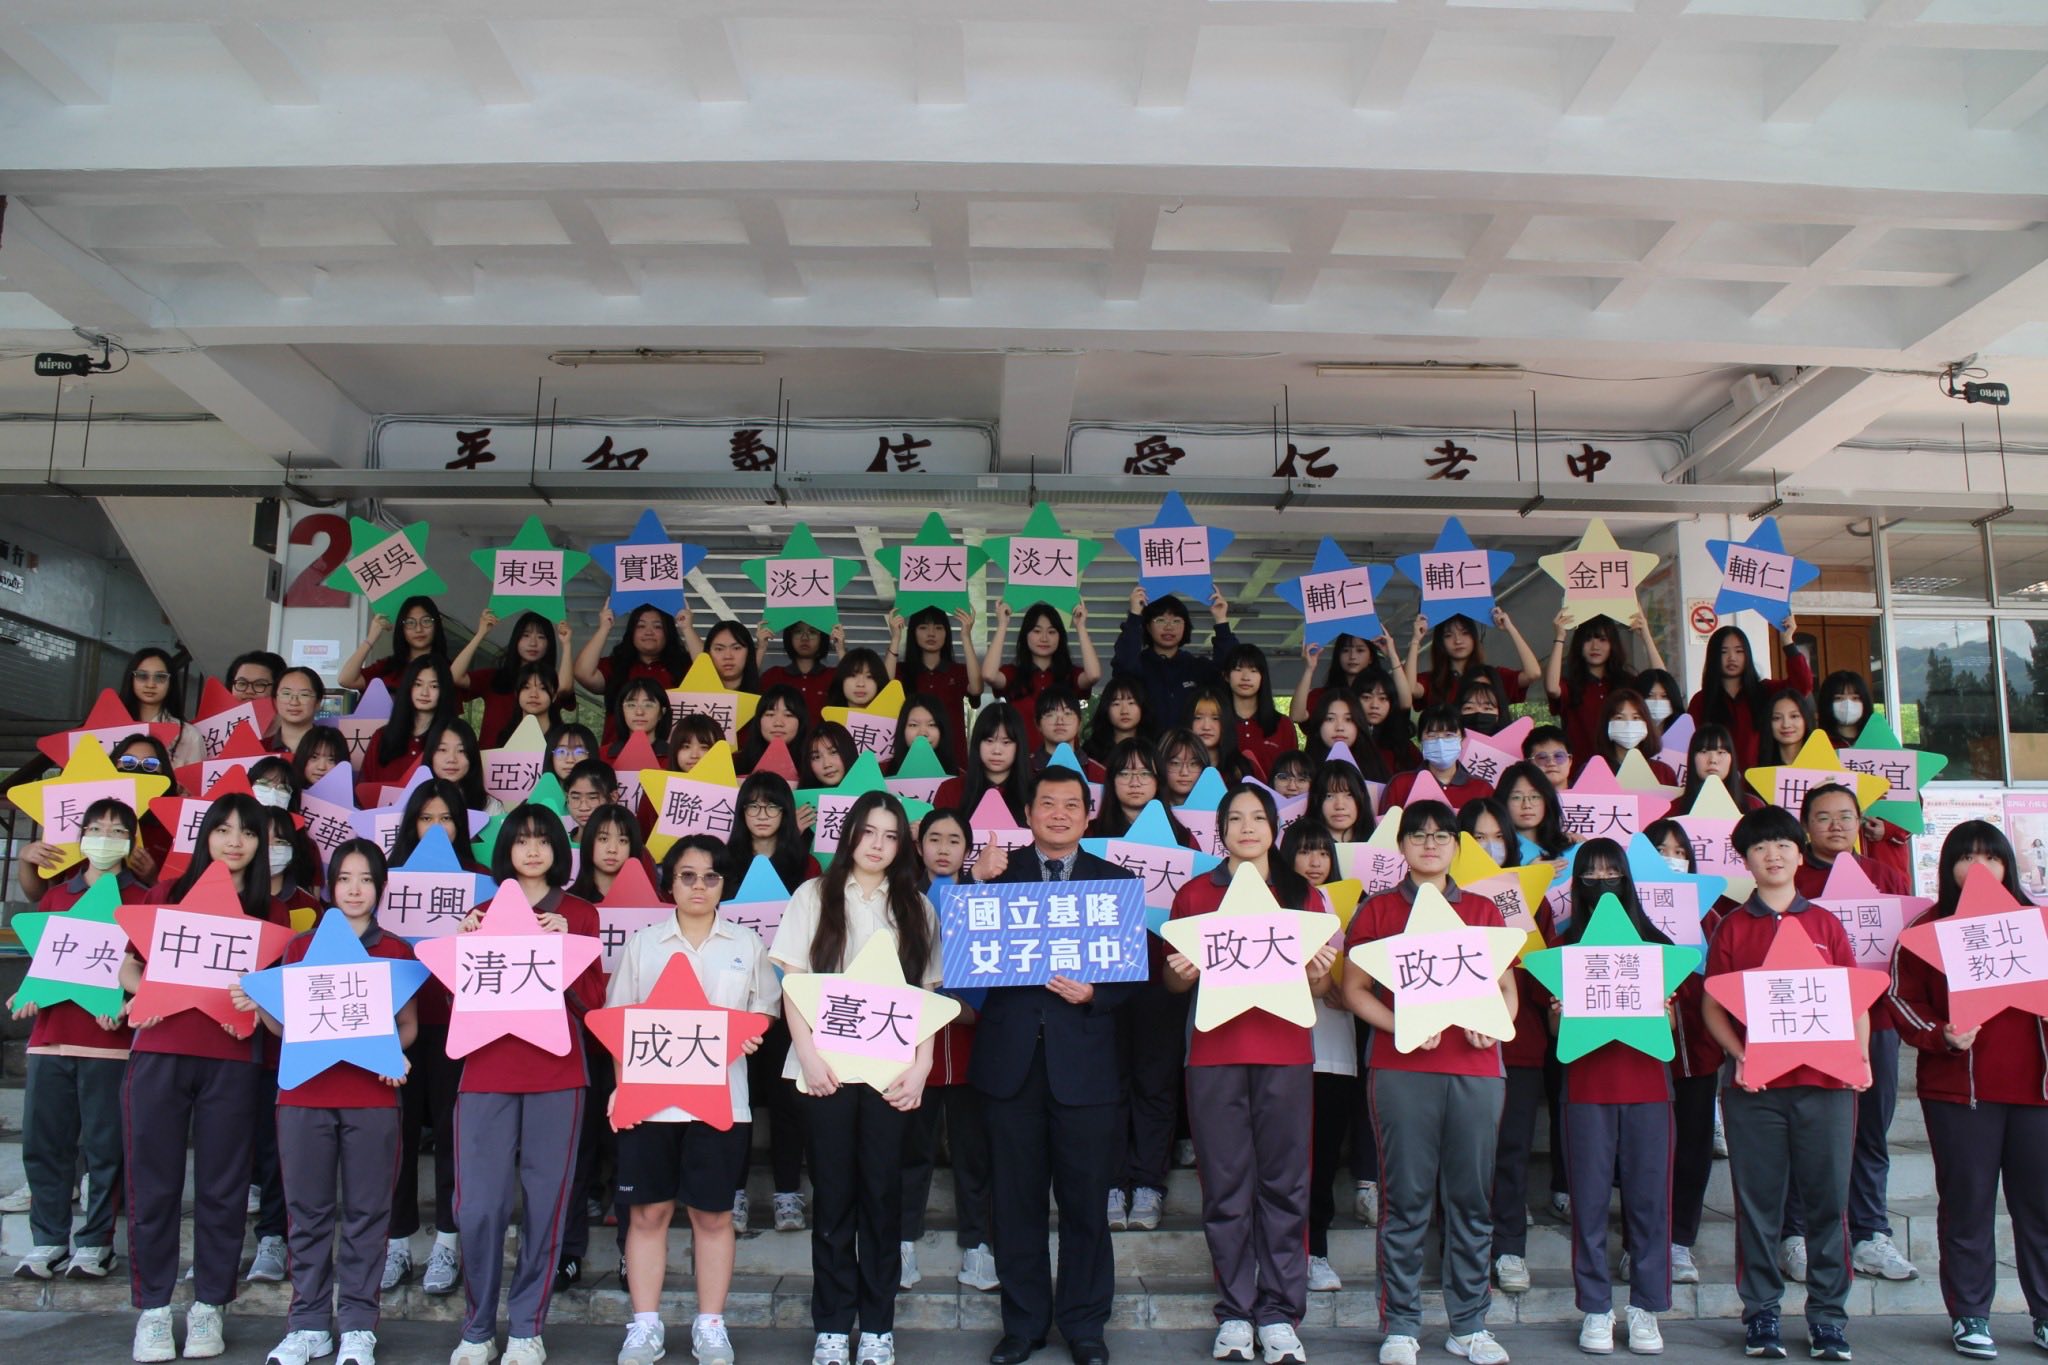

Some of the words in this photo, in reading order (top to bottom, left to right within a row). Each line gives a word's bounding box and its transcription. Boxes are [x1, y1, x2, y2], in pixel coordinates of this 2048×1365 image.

[284, 513, 352, 608] 2
[355, 543, 417, 592] 東吳
[619, 553, 679, 583] 實踐
[903, 555, 963, 582] 淡大
[1013, 547, 1073, 577] 淡大
[1143, 539, 1205, 568] 輔仁
[498, 559, 558, 587] 東吳
[770, 568, 830, 598] 淡大
[1424, 554, 1486, 588] 輔仁
[1567, 558, 1630, 591] 金門
[1728, 555, 1786, 590] 輔仁
[1306, 580, 1368, 611] 輔仁
[665, 790, 736, 832] 聯合
[1561, 804, 1633, 835] 嘉大
[1113, 853, 1186, 895] 海大
[387, 885, 467, 924] 中興
[968, 893, 1120, 931] 國立基隆
[1493, 889, 1522, 919] 醫
[160, 924, 253, 974] 中正
[1204, 926, 1297, 972] 政大
[1962, 920, 2023, 950] 臺北
[52, 933, 119, 974] 中央
[969, 937, 1122, 975] 女子高中
[1395, 944, 1488, 991] 政大
[1584, 953, 1640, 980] 臺灣
[1968, 951, 2031, 981] 教大
[307, 971, 368, 1002] 臺北
[461, 949, 557, 995] 清大
[1585, 983, 1642, 1011] 師範
[1767, 976, 1827, 1005] 臺北
[309, 1003, 370, 1034] 大學
[820, 994, 913, 1046] 臺大
[1769, 1007, 1831, 1036] 市大
[627, 1023, 721, 1068] 成大
